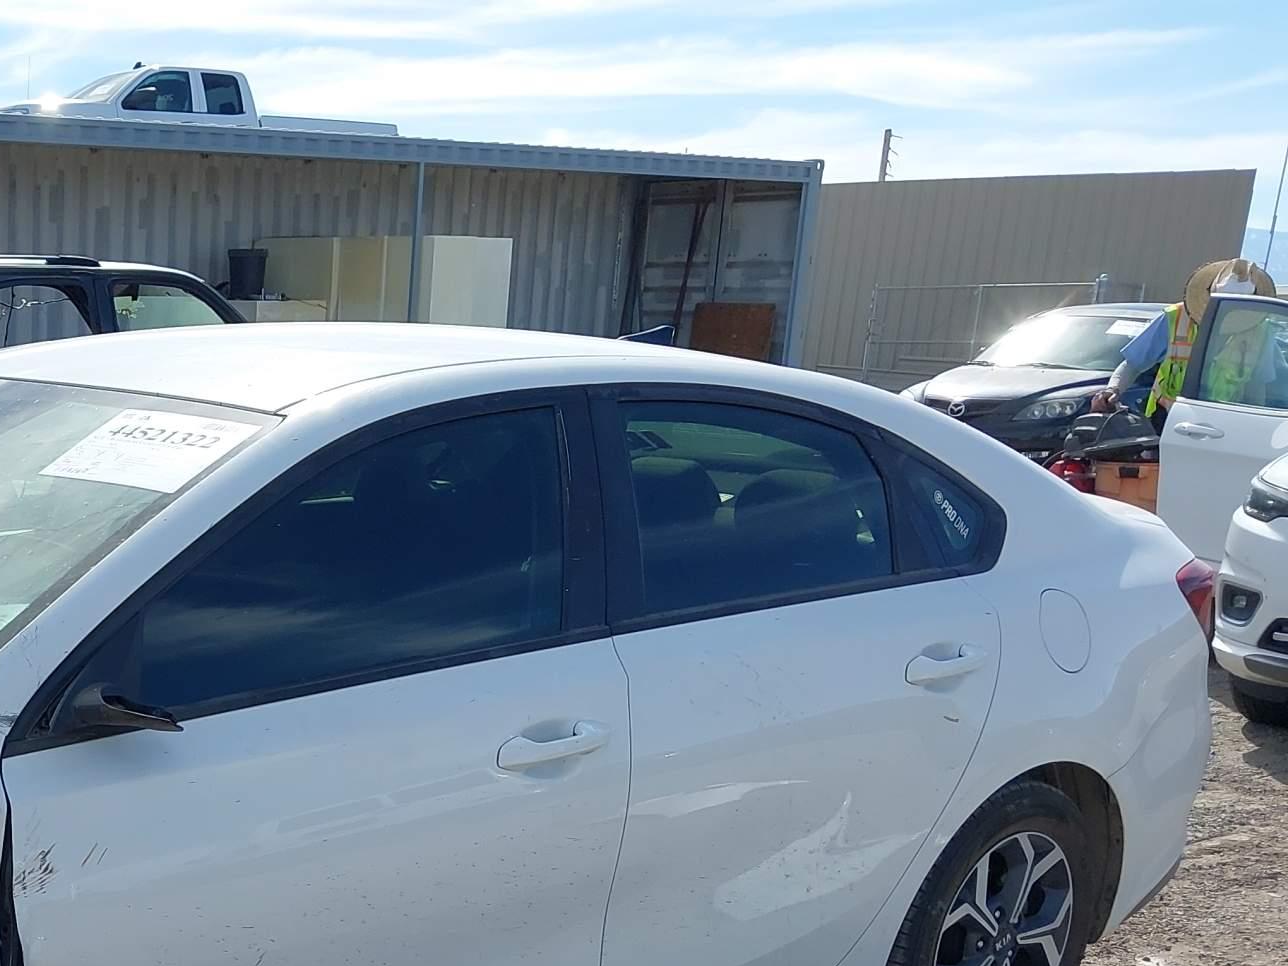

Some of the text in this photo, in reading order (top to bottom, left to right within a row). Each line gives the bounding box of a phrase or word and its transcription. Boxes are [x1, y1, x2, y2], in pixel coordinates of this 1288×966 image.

[109, 424, 220, 448] 44521322
[941, 499, 970, 538] PRO DNA
[996, 934, 1011, 951] KIA
